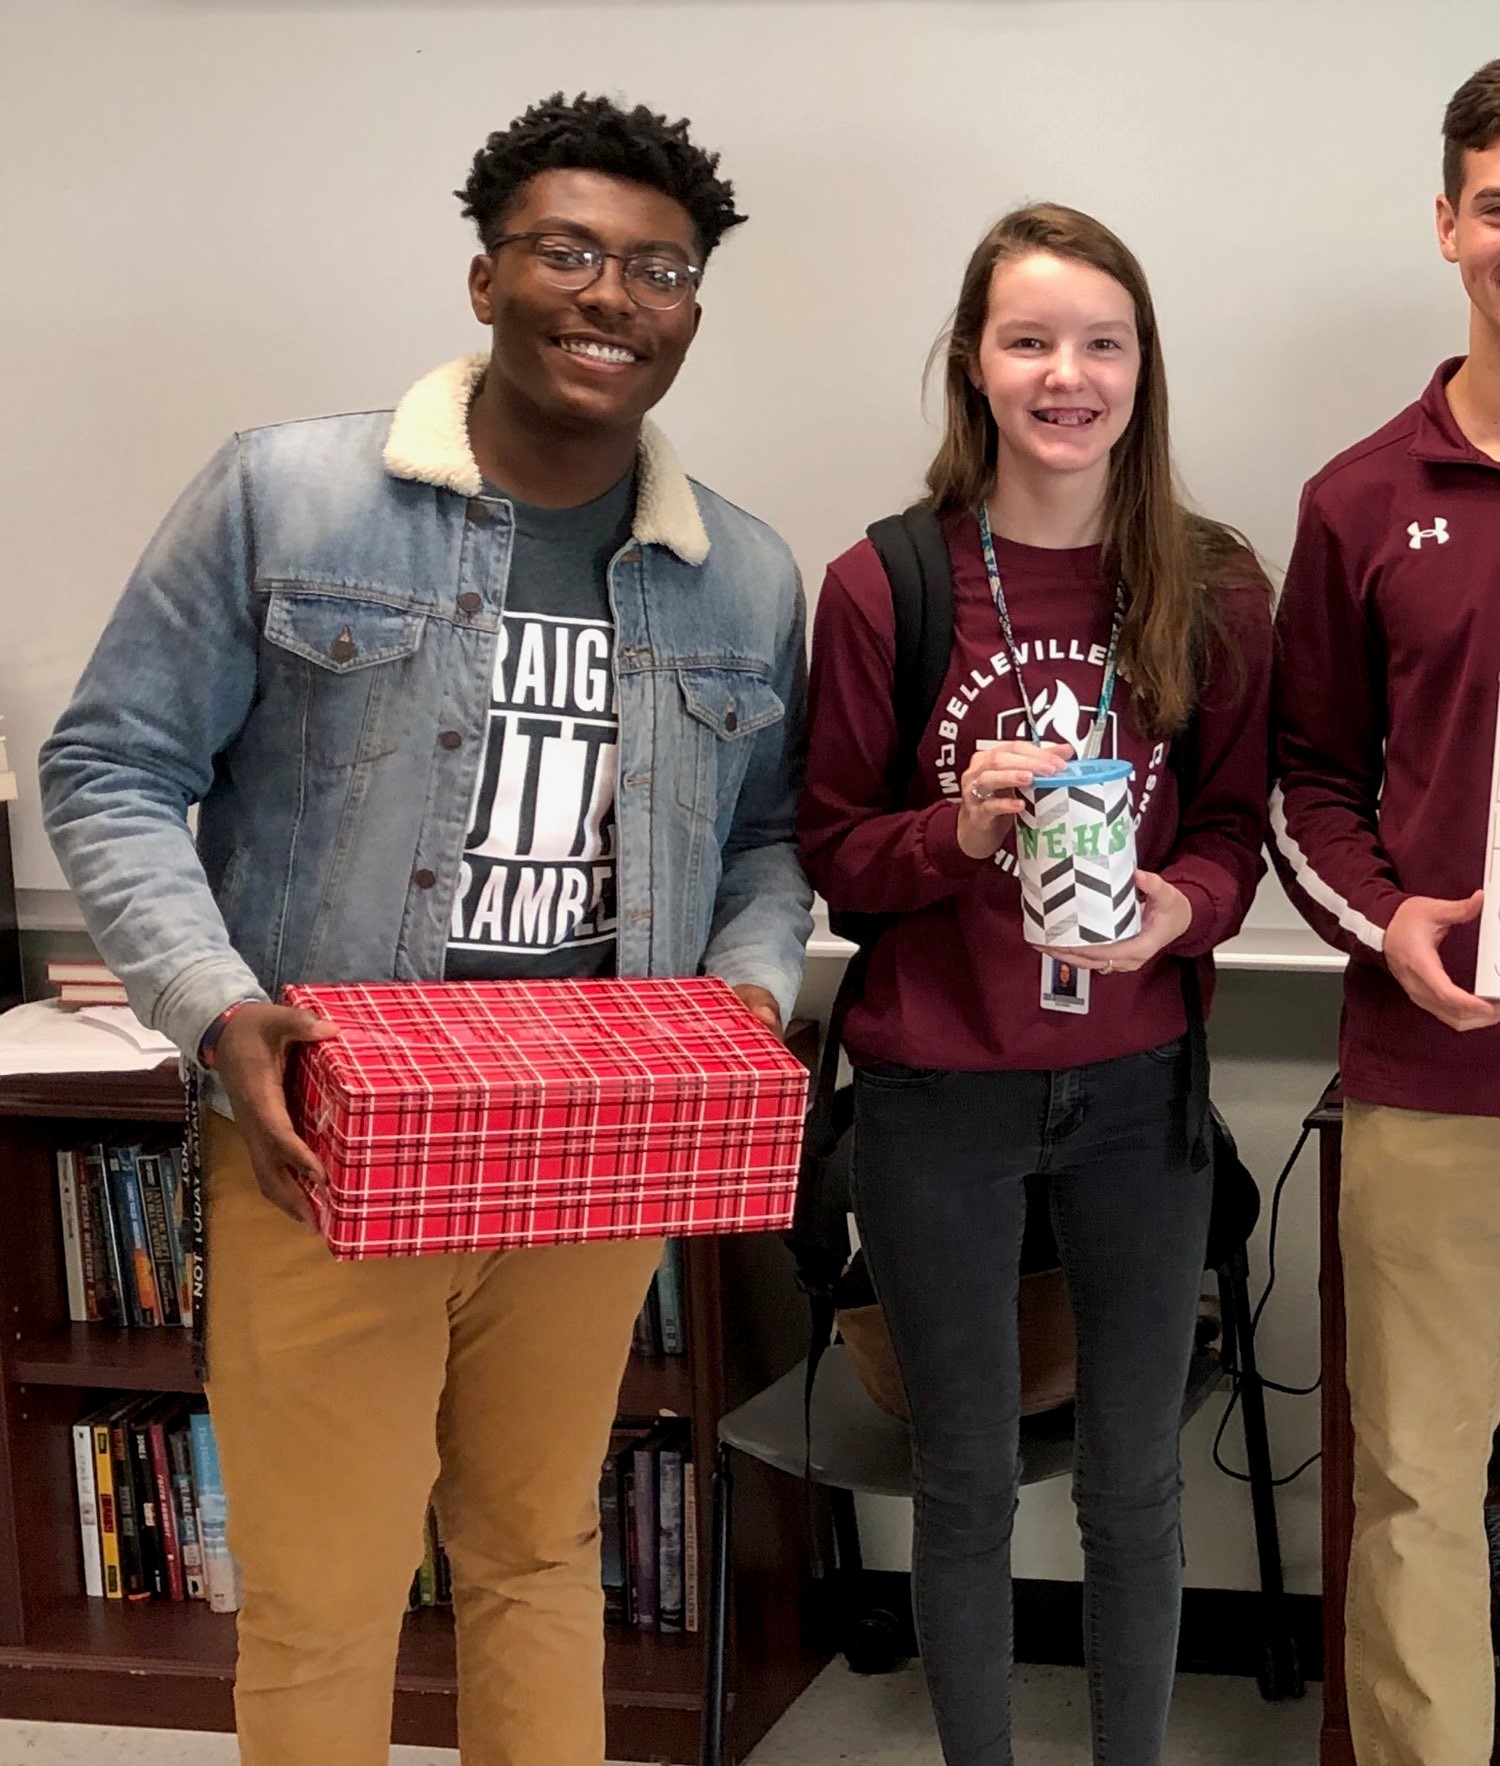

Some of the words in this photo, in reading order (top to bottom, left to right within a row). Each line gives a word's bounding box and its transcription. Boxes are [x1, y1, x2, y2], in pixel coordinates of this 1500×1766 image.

[947, 638, 1107, 742] BELLEVILLE
[1017, 817, 1127, 861] NEHS
[193, 1252, 203, 1297] NOT
